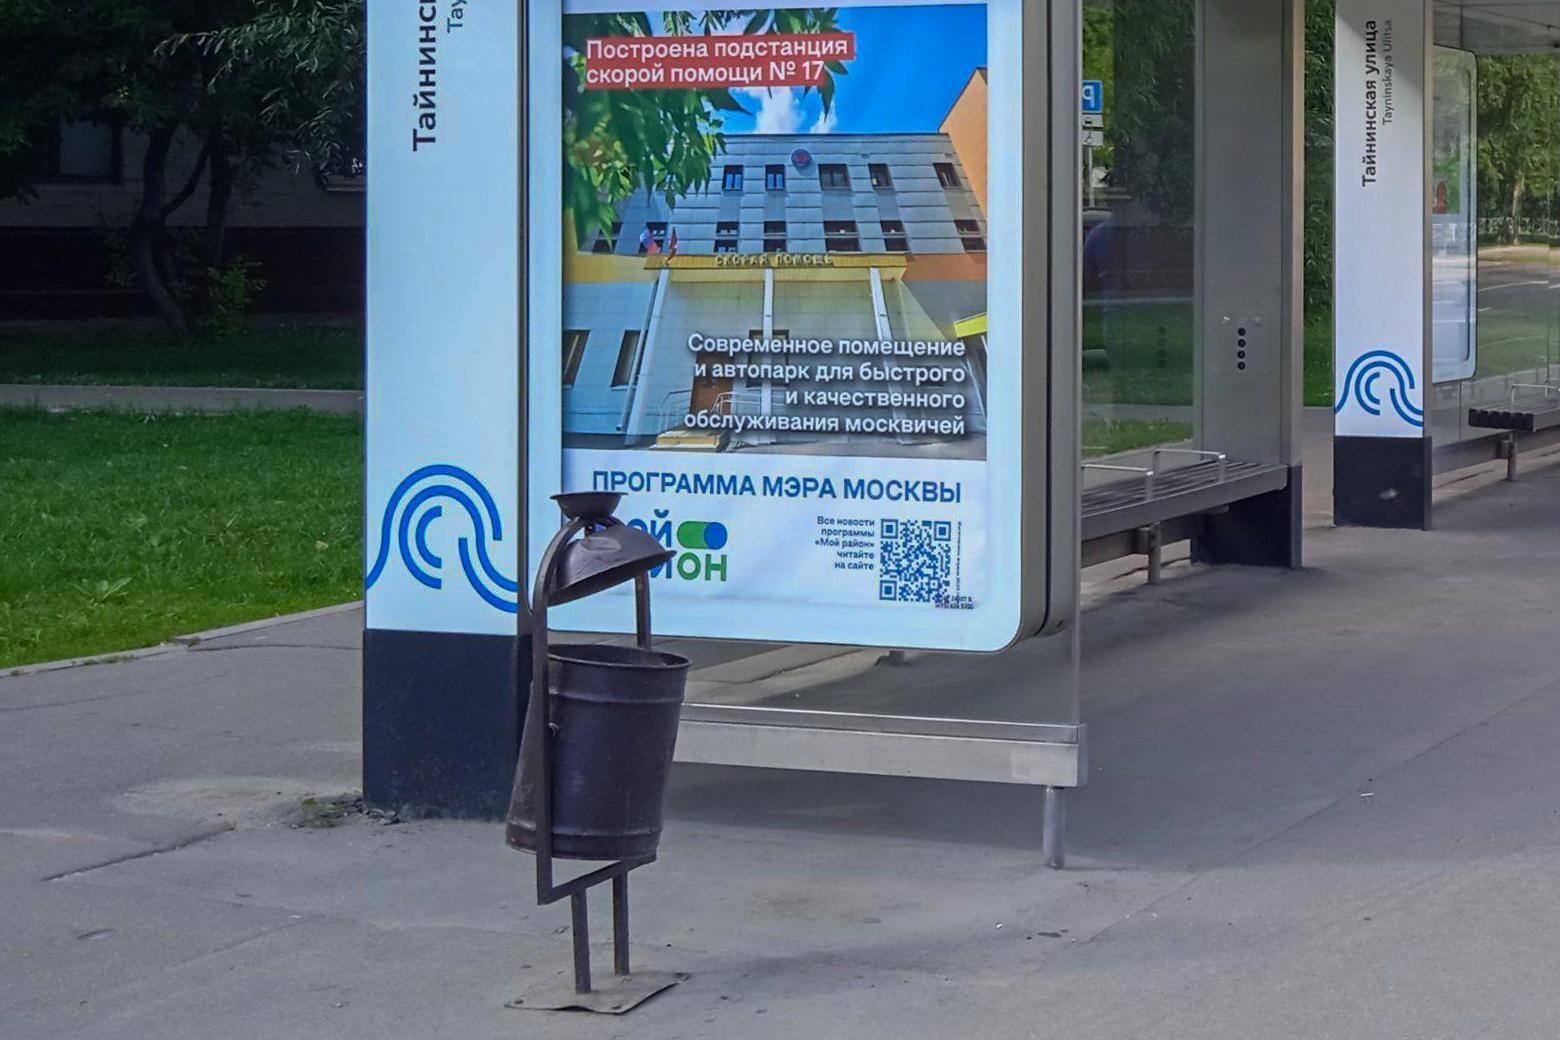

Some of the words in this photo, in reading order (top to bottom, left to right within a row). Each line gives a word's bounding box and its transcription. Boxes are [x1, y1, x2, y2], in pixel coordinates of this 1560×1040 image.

[1365, 20, 1380, 74] улица
[1382, 19, 1393, 52] Ulitsa
[586, 39, 708, 62] Построена
[714, 37, 848, 61] подстанция
[586, 63, 664, 87] скорой
[670, 67, 762, 87] помощи
[768, 61, 796, 81] №
[801, 61, 824, 81] 17
[1382, 55, 1395, 125] Tayninskaya
[1362, 81, 1377, 187] Тайнинская
[688, 333, 833, 357] Современное
[839, 339, 965, 358] помещение
[695, 365, 706, 377] и
[712, 365, 809, 383] автопарк
[816, 368, 853, 382] для
[859, 362, 965, 385] быстрого
[786, 391, 797, 404] и
[804, 391, 965, 408] качественного
[684, 413, 839, 432] обслуживания
[845, 415, 965, 435] москвичей
[593, 471, 756, 496] ПРОГРАММА
[763, 476, 837, 499] МЭРА
[843, 478, 961, 503] МОСКВЫ
[817, 516, 835, 525] Все
[836, 518, 875, 526] новости
[821, 528, 875, 537] программы
[815, 537, 840, 546] «Мой
[842, 539, 875, 549] район»
[837, 550, 875, 559] читайте
[847, 560, 874, 570] сайте
